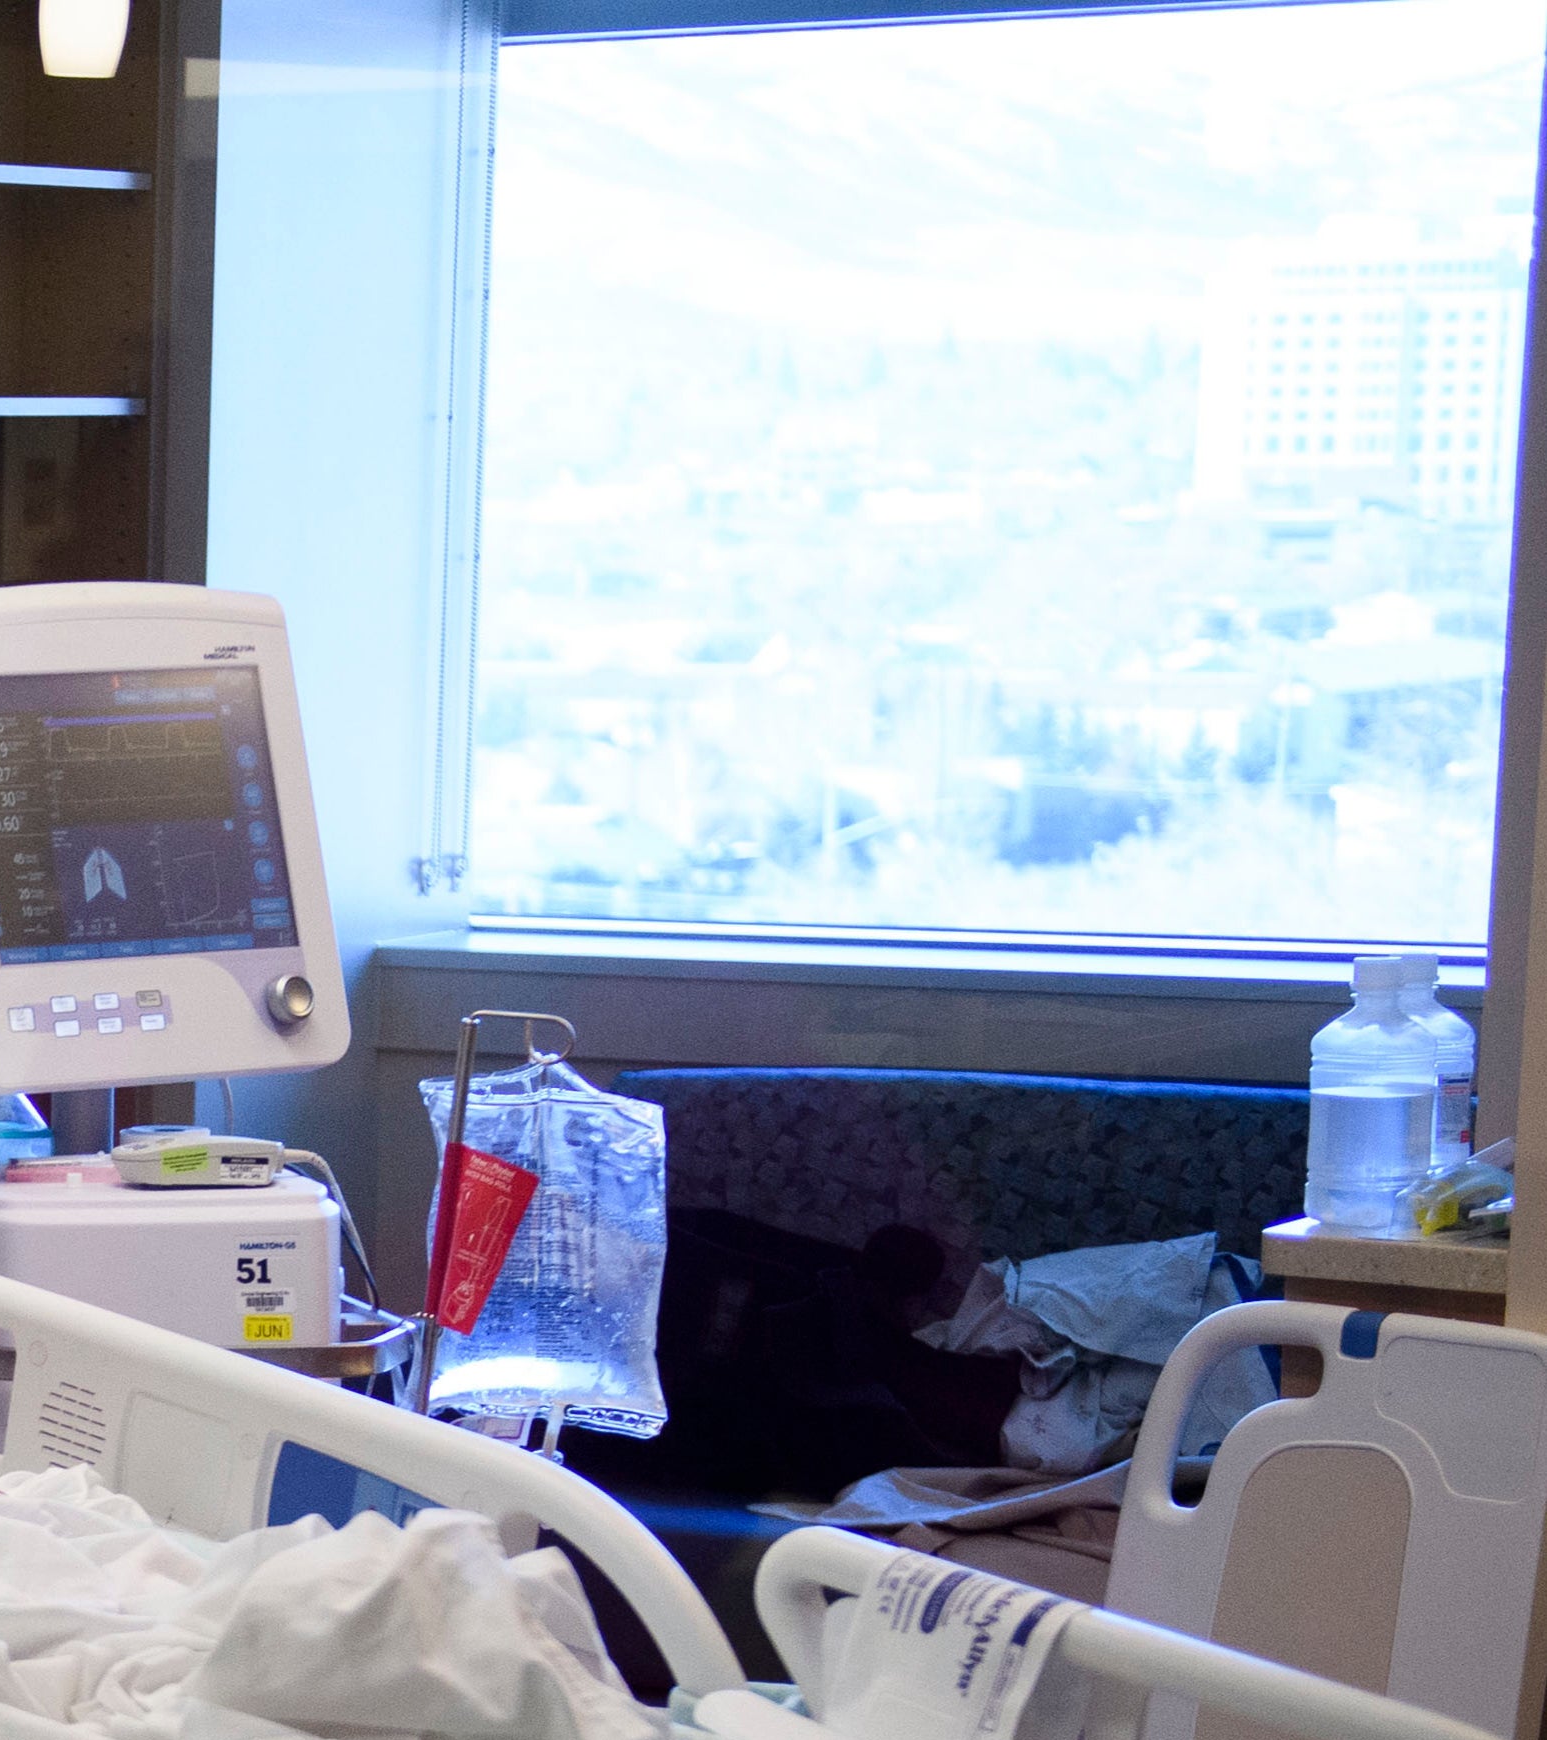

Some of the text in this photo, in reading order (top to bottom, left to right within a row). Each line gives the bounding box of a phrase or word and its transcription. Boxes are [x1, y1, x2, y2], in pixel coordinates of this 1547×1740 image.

[0, 791, 16, 808] 30
[236, 1258, 272, 1284] 51
[254, 1324, 283, 1338] JUN
